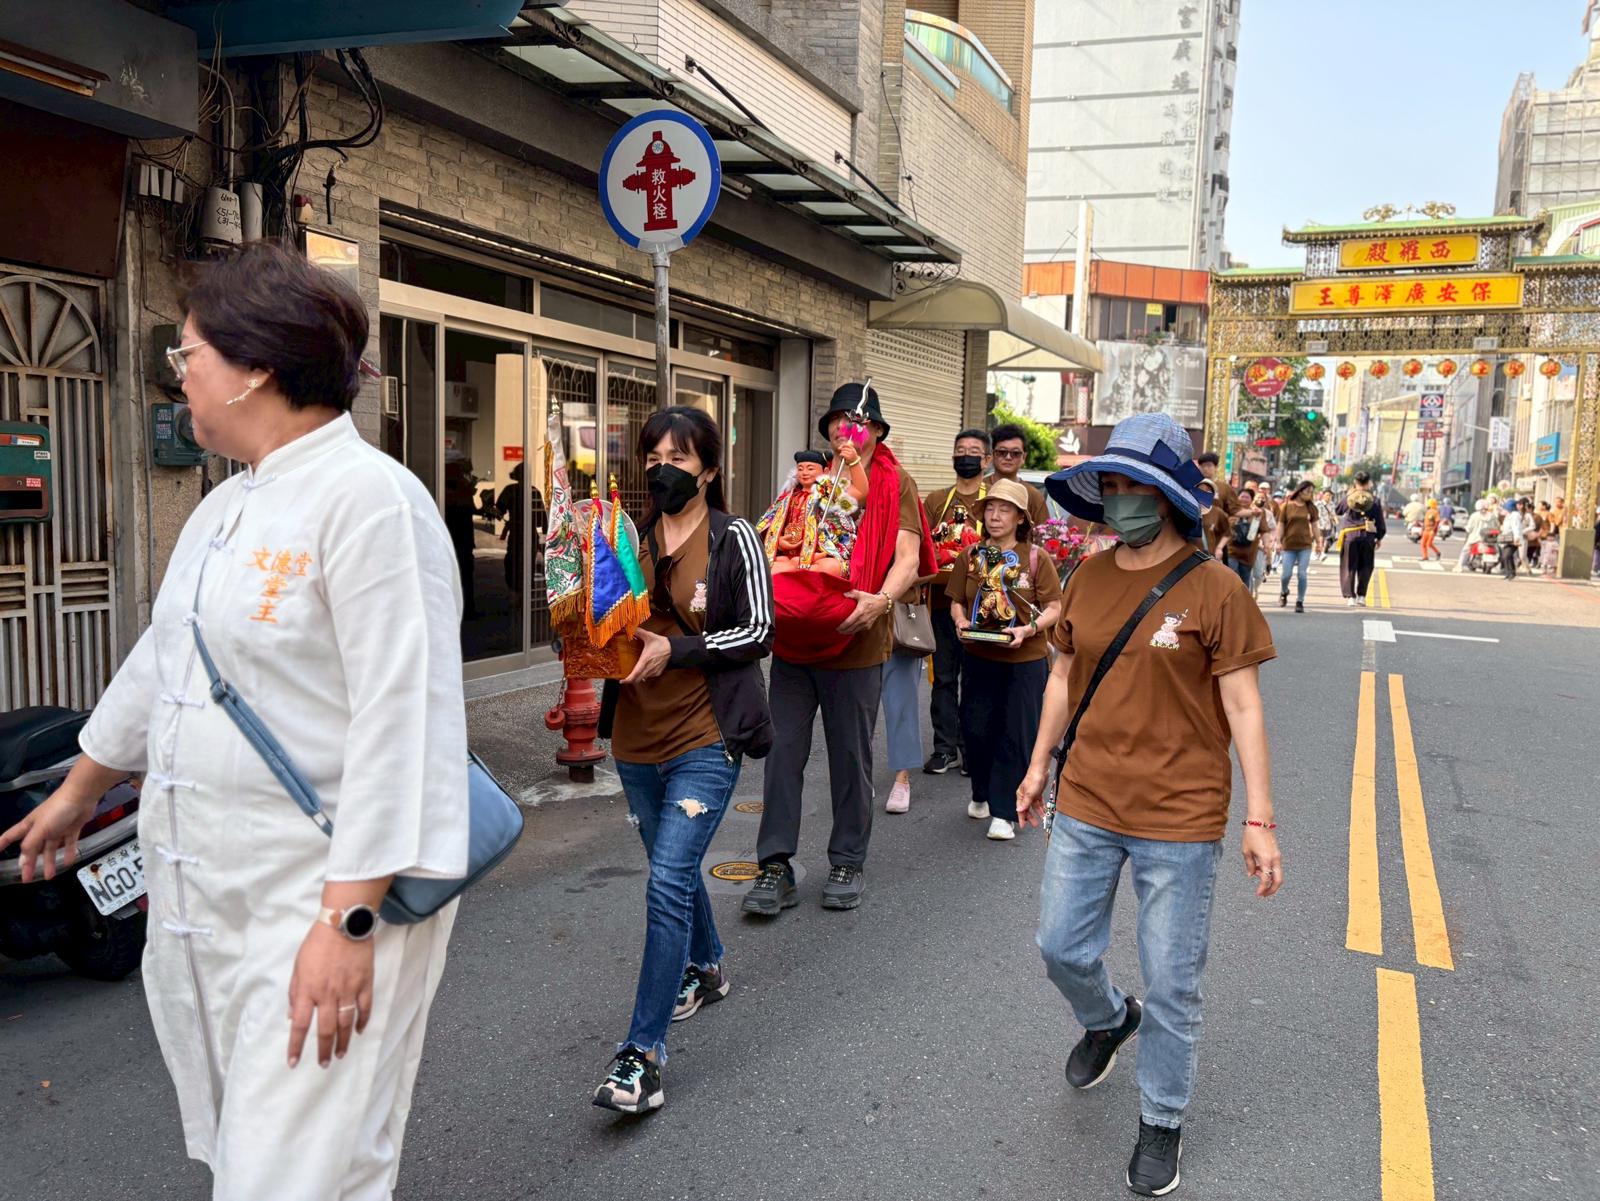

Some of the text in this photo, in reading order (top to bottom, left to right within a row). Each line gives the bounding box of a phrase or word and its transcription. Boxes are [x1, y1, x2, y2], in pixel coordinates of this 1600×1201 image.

[651, 168, 668, 220] 救火栓
[1365, 239, 1451, 263] 西羅殿
[1317, 281, 1492, 307] 保安廣澤尊王
